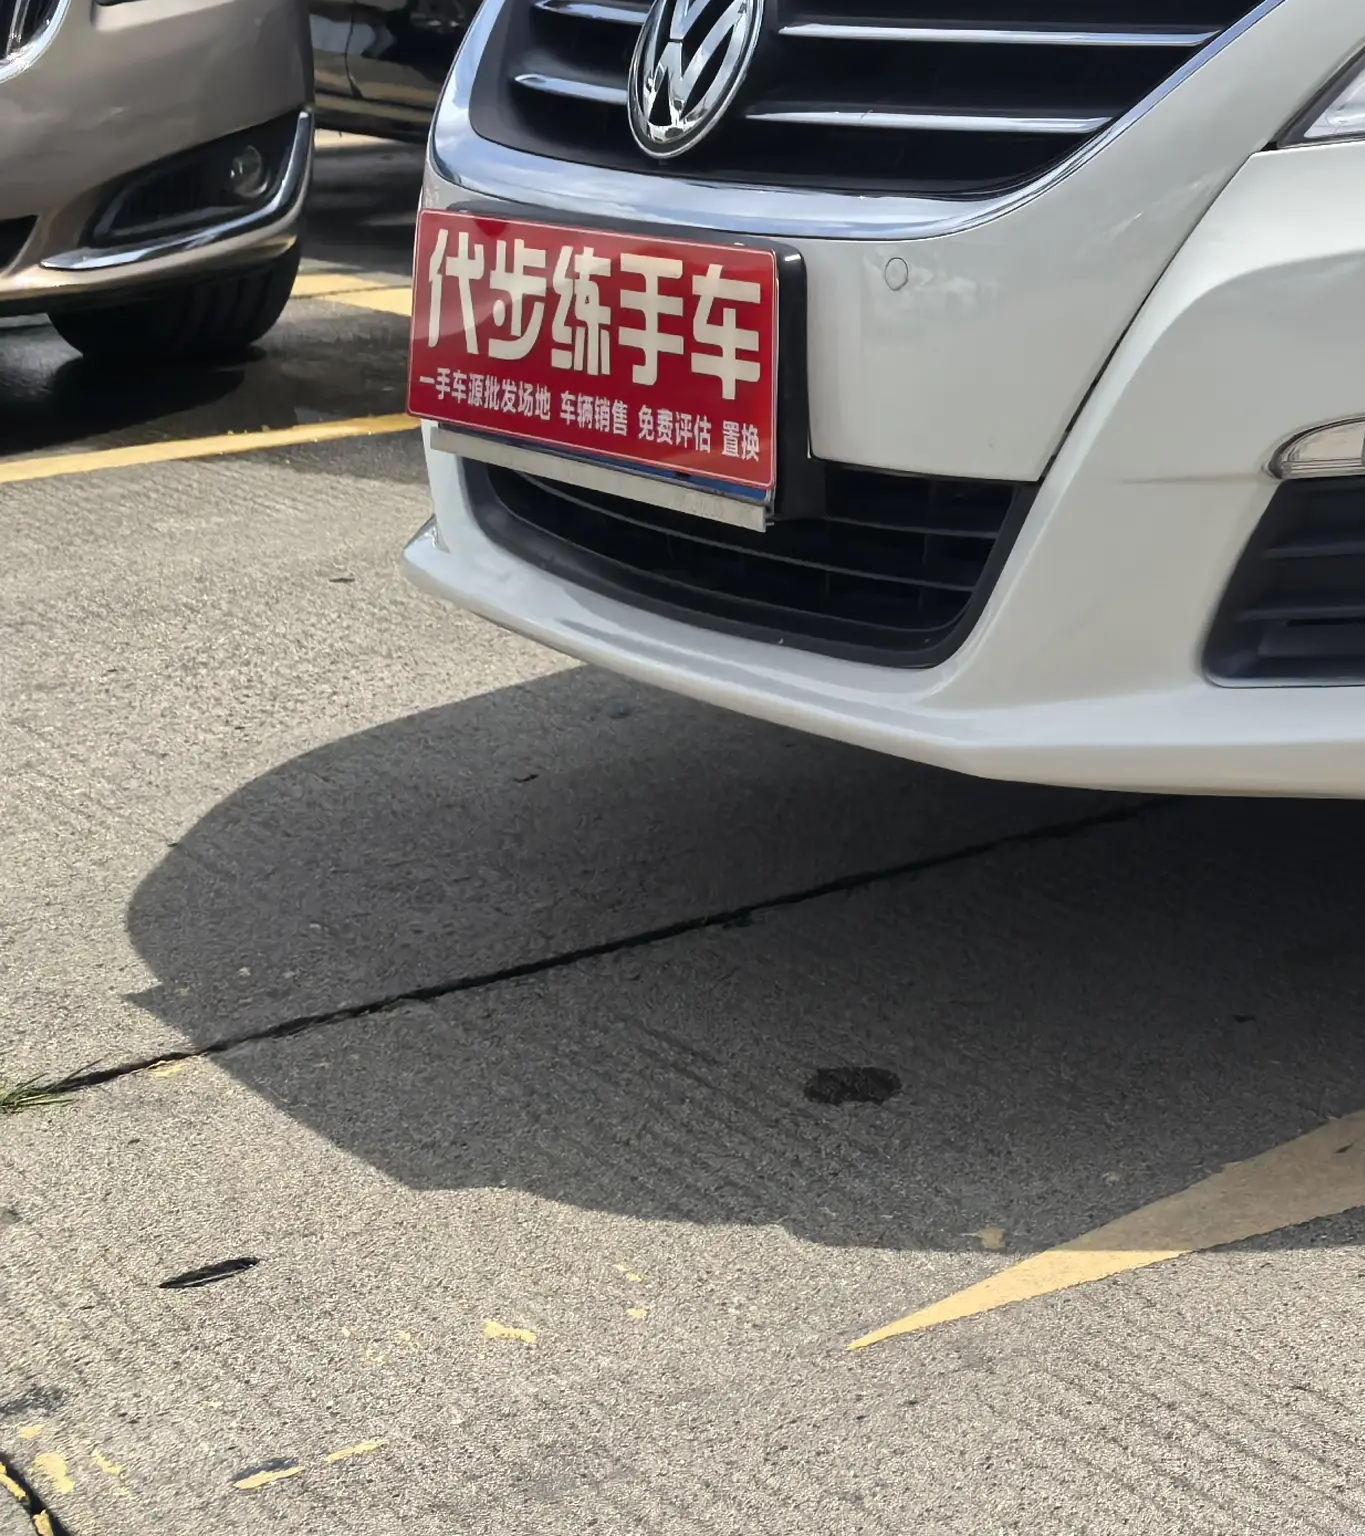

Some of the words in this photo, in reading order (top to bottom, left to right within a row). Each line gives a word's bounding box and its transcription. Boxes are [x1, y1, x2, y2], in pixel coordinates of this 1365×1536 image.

[428, 228, 762, 401] 代步练手车
[419, 367, 551, 421] 一手车源批发场地
[560, 390, 629, 436] 车辆销售
[638, 405, 712, 454] 免费评估
[721, 421, 760, 462] 置换
